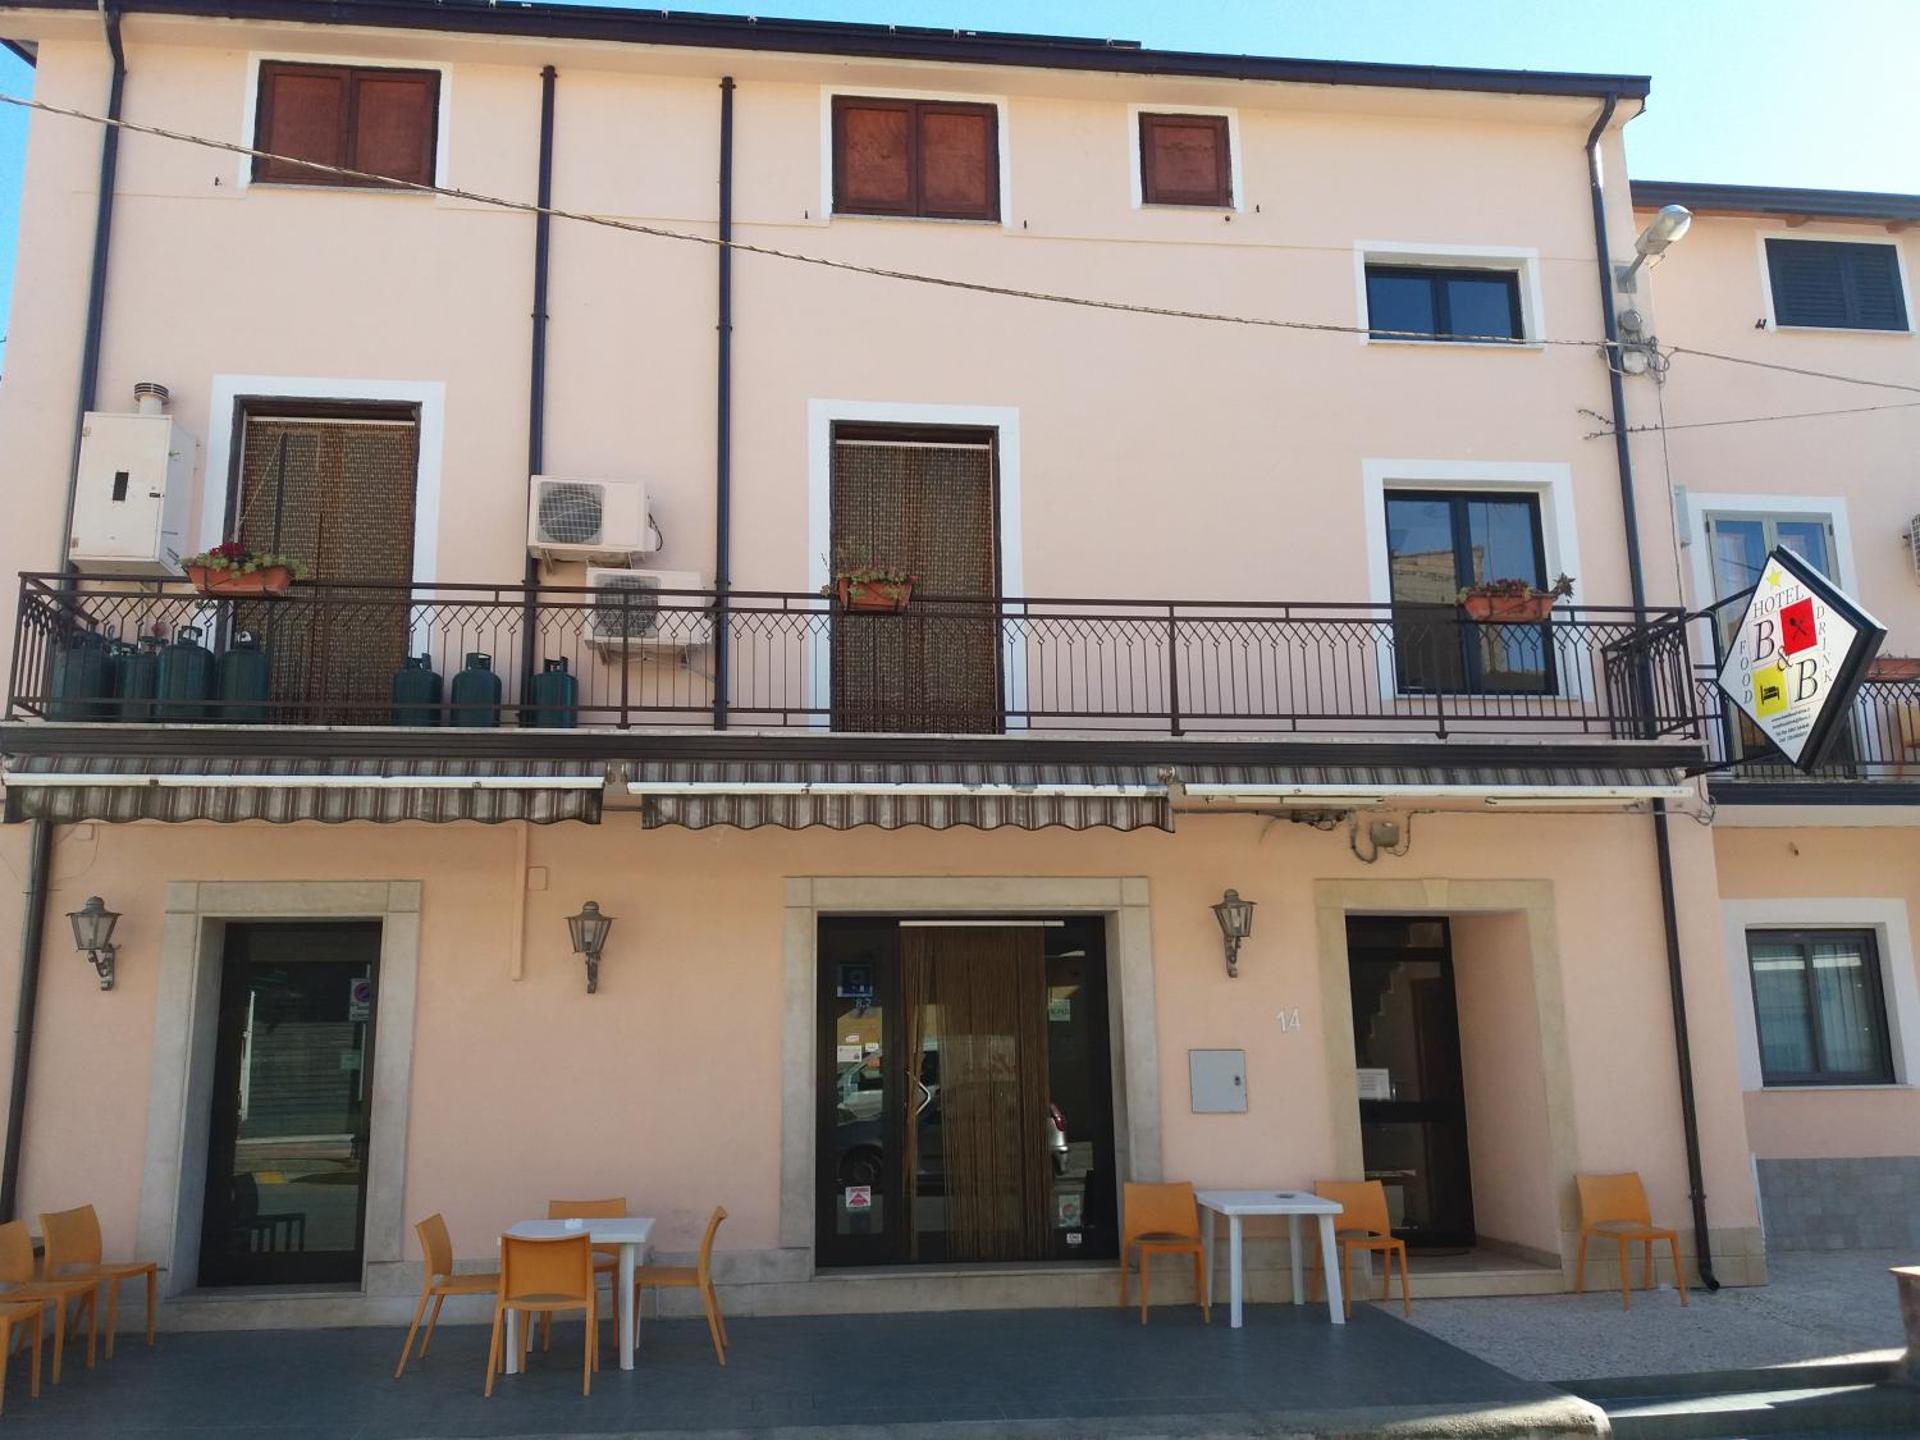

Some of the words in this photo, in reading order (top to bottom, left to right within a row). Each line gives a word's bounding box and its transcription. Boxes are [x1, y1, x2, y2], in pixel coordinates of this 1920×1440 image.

[1753, 584, 1805, 618] HOTEL
[1739, 639, 1754, 705] FOOD
[1752, 619, 1775, 662] B
[1777, 644, 1792, 672] &
[1794, 658, 1818, 703] B
[1816, 605, 1834, 684] DRINK
[1275, 1007, 1302, 1033] 14
